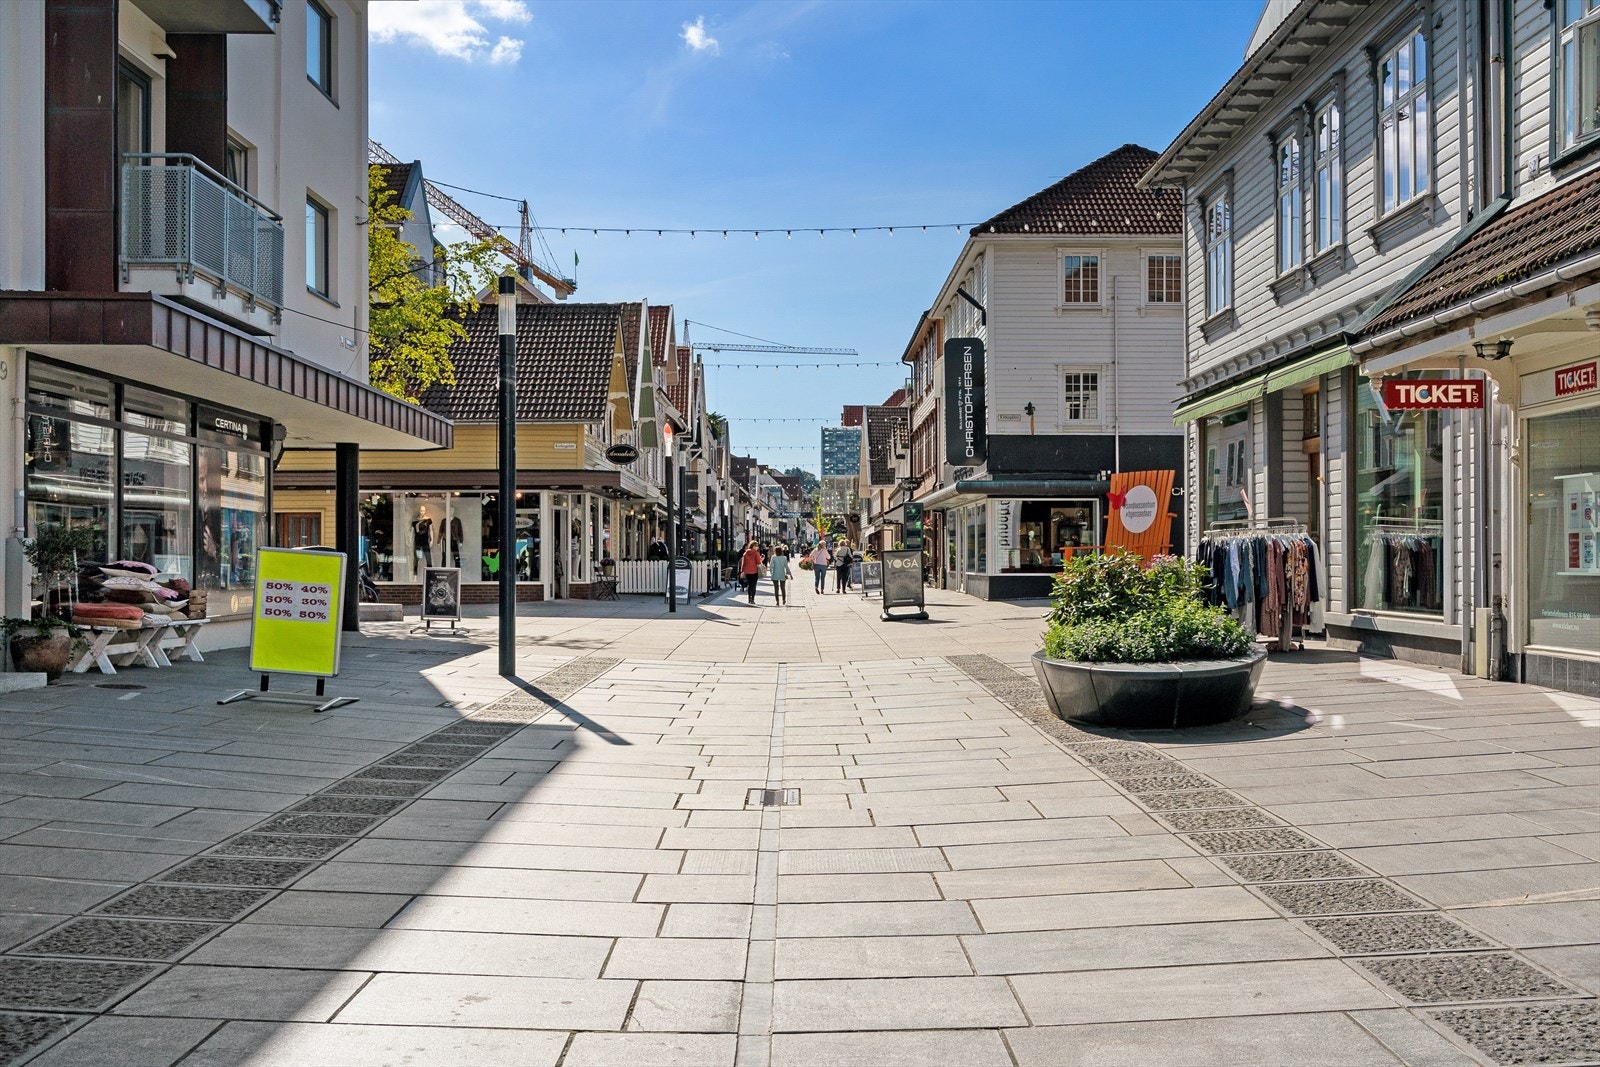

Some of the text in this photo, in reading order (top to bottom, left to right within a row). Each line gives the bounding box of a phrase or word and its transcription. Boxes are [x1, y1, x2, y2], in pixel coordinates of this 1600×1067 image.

[1558, 367, 1594, 390] TICKET
[1395, 384, 1477, 404] TICKET
[964, 346, 975, 457] CHRISTOPHERSEN
[215, 417, 242, 432] CERTINA
[887, 558, 919, 569] YOGA
[266, 582, 328, 594] 50% 40%
[265, 596, 327, 606] 50% 30%
[264, 608, 327, 620] 50% 50%
